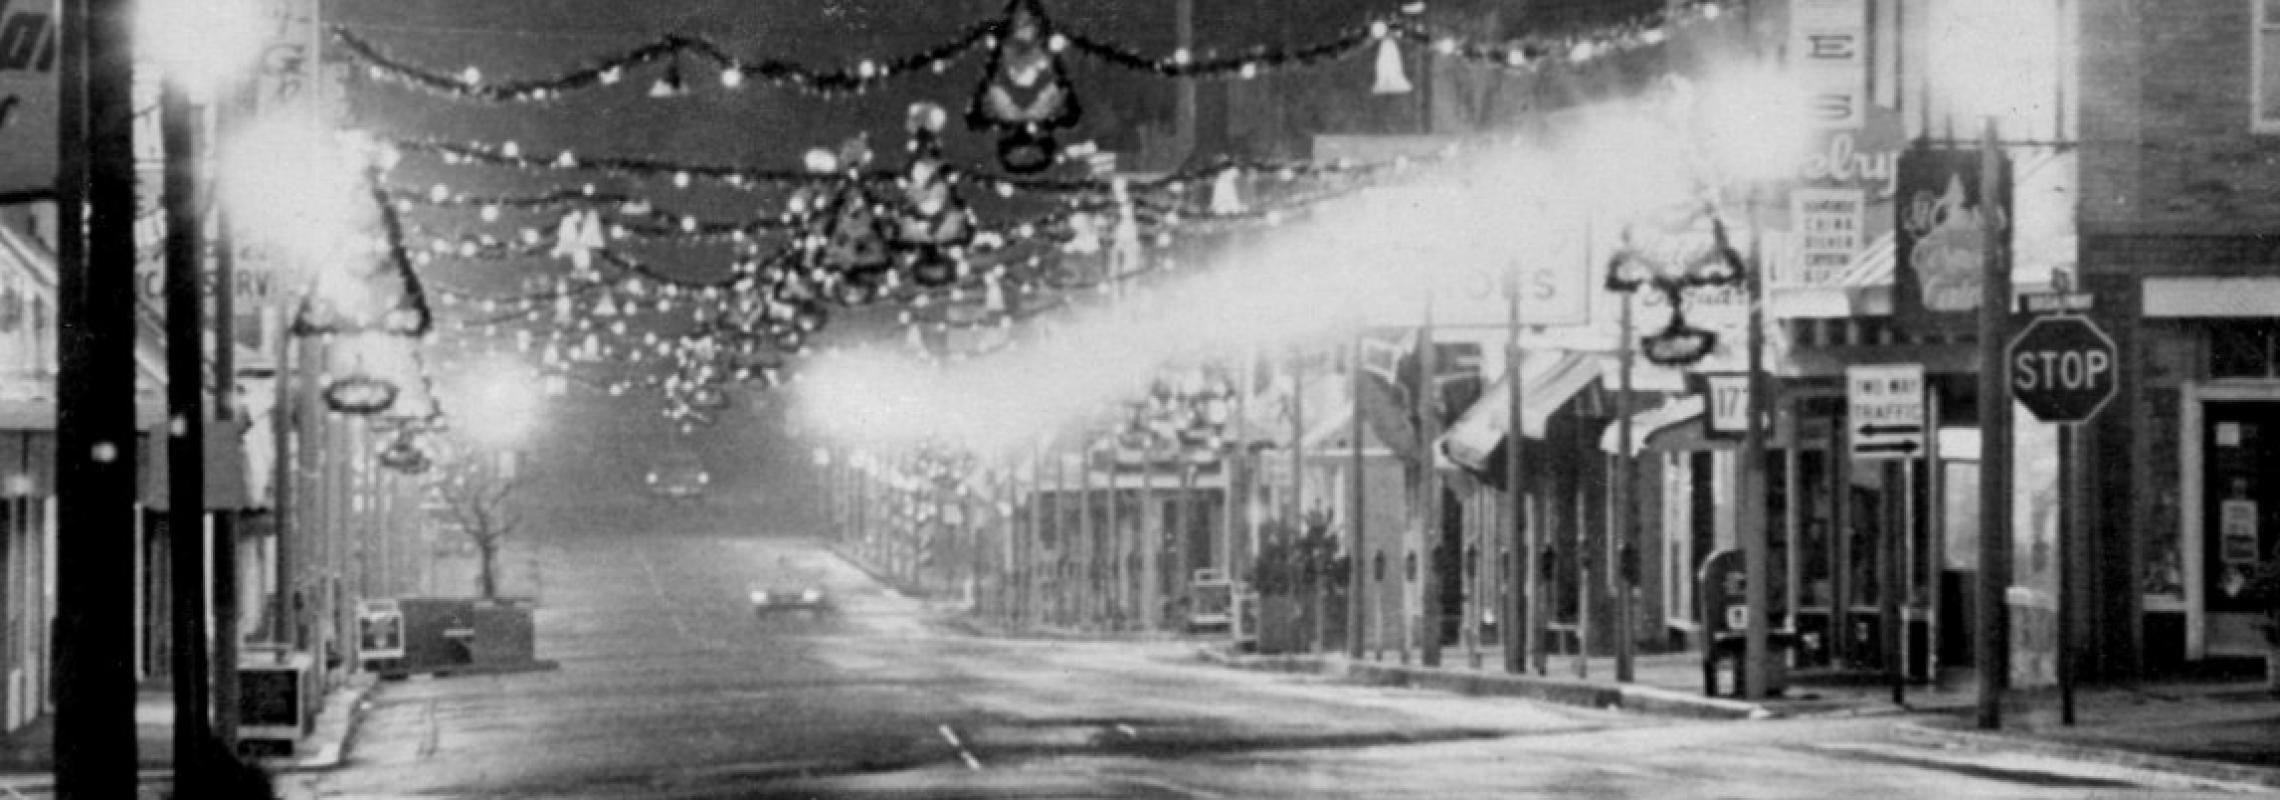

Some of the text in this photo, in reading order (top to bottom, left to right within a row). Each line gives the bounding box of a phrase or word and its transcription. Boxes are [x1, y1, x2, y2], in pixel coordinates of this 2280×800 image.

[2014, 350, 2108, 390] STOP
[1856, 377, 1919, 395] TWO WAY
[1855, 403, 1922, 421] TRAFFIC
